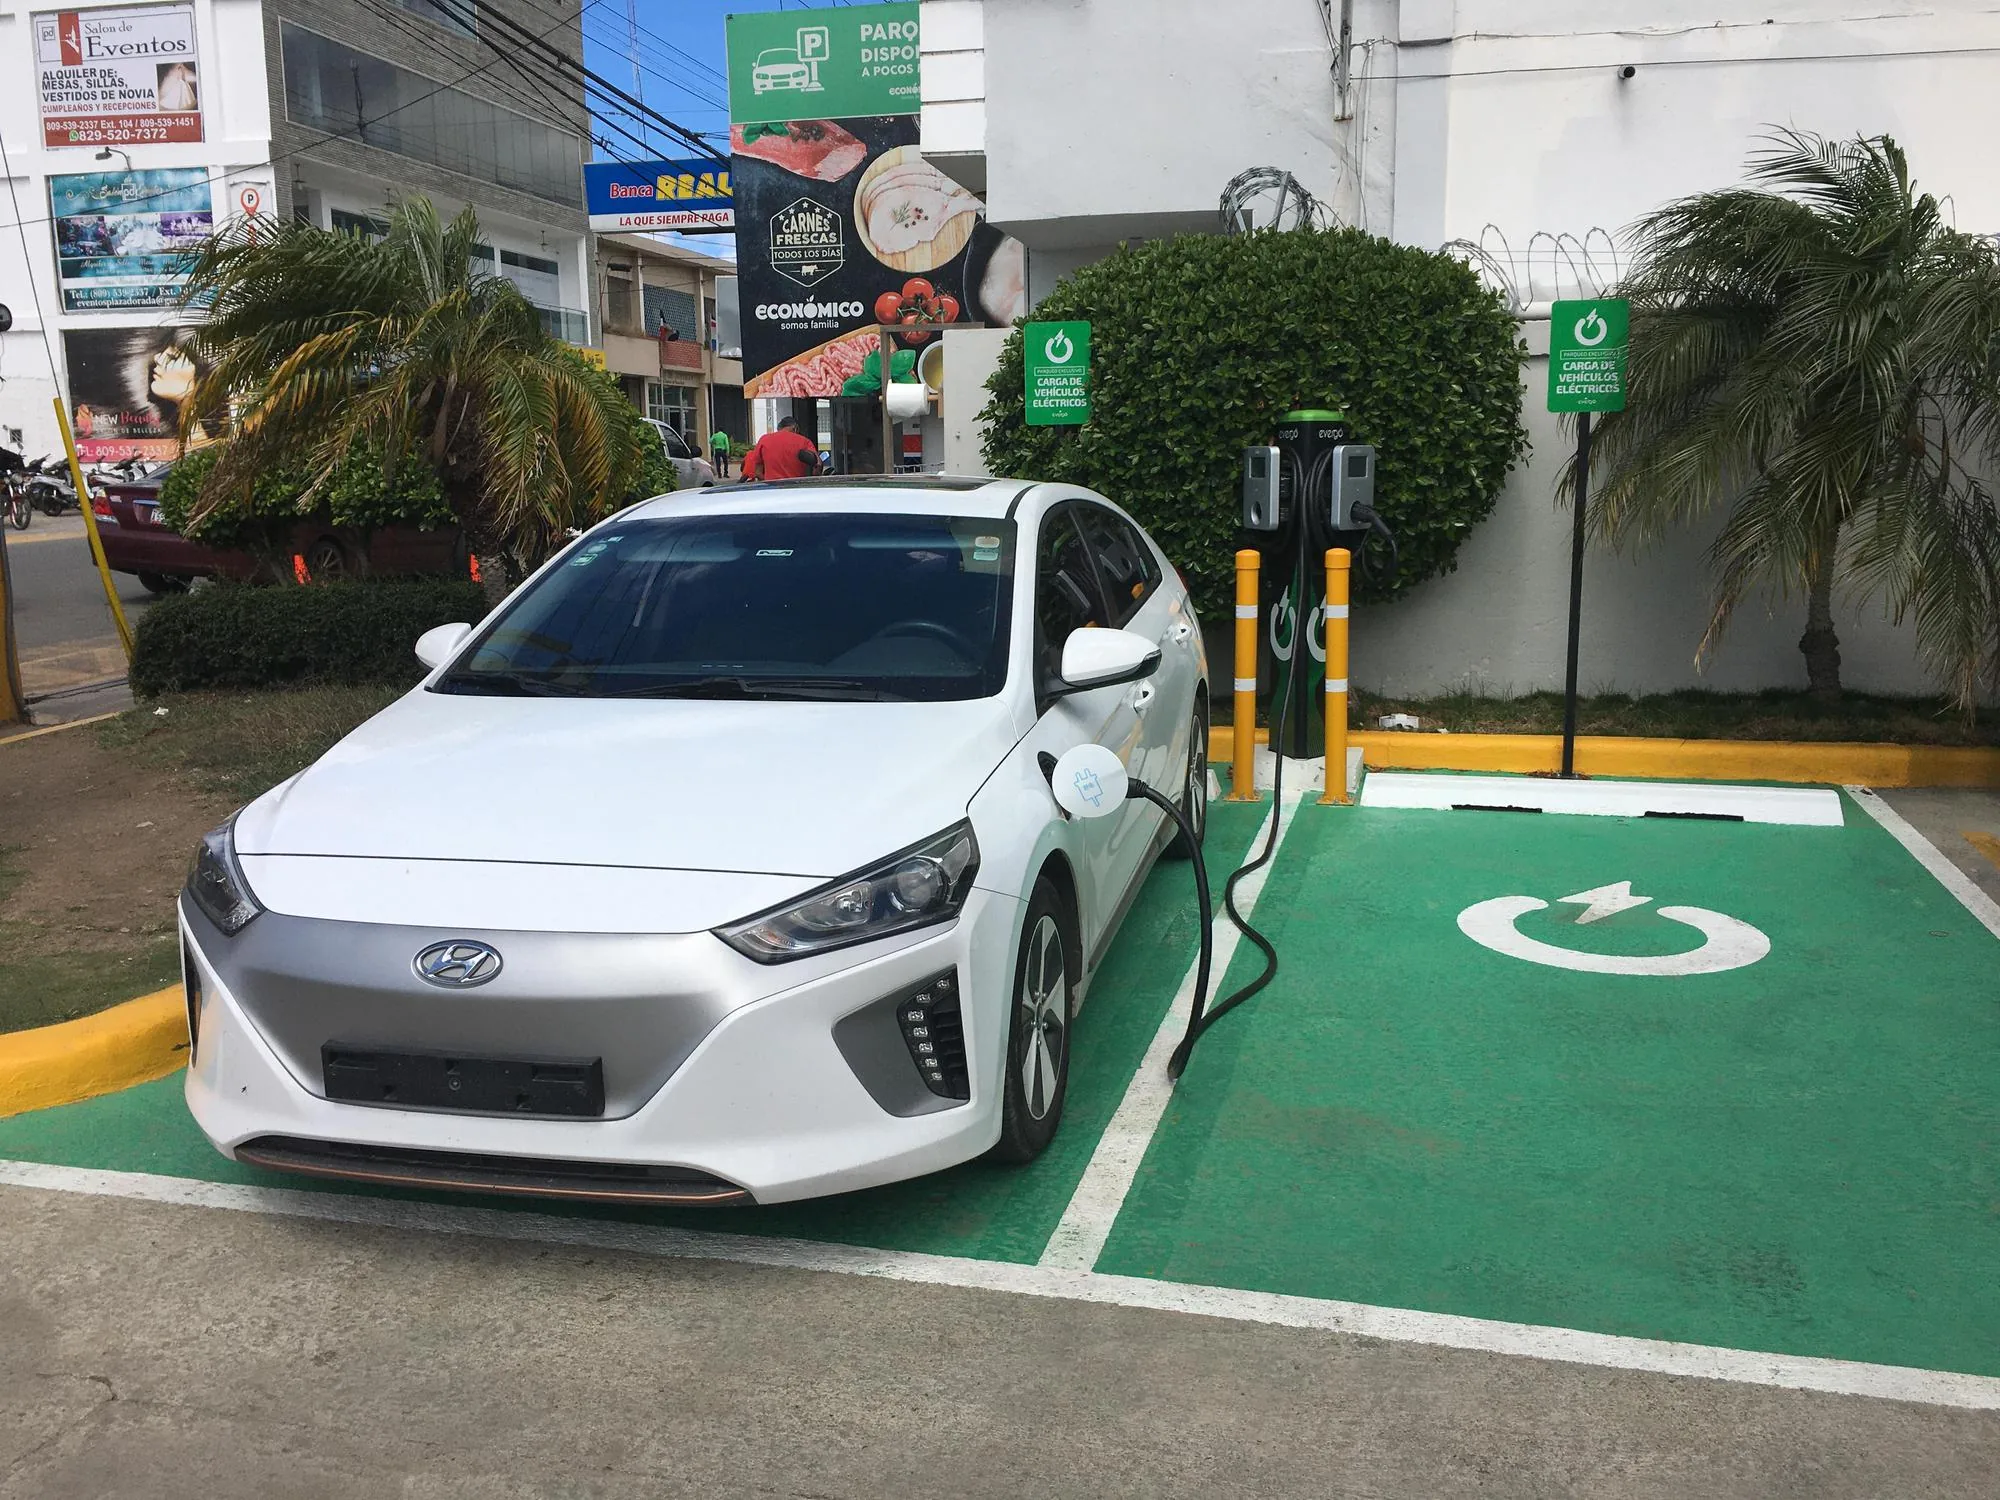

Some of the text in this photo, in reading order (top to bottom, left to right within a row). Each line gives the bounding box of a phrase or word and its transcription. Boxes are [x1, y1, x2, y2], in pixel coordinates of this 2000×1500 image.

[84, 20, 133, 35] Salon de
[85, 35, 187, 58] Eventos
[42, 67, 118, 81] ALQUILER DE:
[861, 66, 871, 78] A
[873, 64, 914, 77] POCOS
[42, 77, 128, 91] MESAS, SILLAS,
[42, 88, 155, 102] VESTIDOS DE NOVIA
[42, 101, 157, 113] CUMPLEAÑOS Y RECEPCIONES
[46, 120, 98, 131] 809-539-2337
[100, 119, 117, 128] Ext.
[118, 118, 133, 128] 104
[139, 117, 195, 128] 809-539-1451
[78, 128, 168, 142] 829-520-7372
[609, 172, 734, 201] Banca REAL
[619, 212, 729, 226] LA QUE SIEMPRE PAGA
[782, 212, 831, 233] CARNES
[776, 232, 838, 245] FRESCAS
[773, 247, 841, 259] TODOS LOS DÍAS
[90, 285, 111, 299] (809)
[158, 286, 176, 296] Ext.
[780, 319, 839, 330] somos familia
[1563, 361, 1616, 371] CARGA DE
[1037, 377, 1083, 386] CARGA DE
[1559, 371, 1619, 382] VEHÍCULOS
[1034, 386, 1086, 397] VEHÍCULOS
[1556, 382, 1620, 394] ELÉCTRICOS
[1032, 397, 1088, 408] ELÉCTRICOS
[94, 414, 119, 425] NEW
